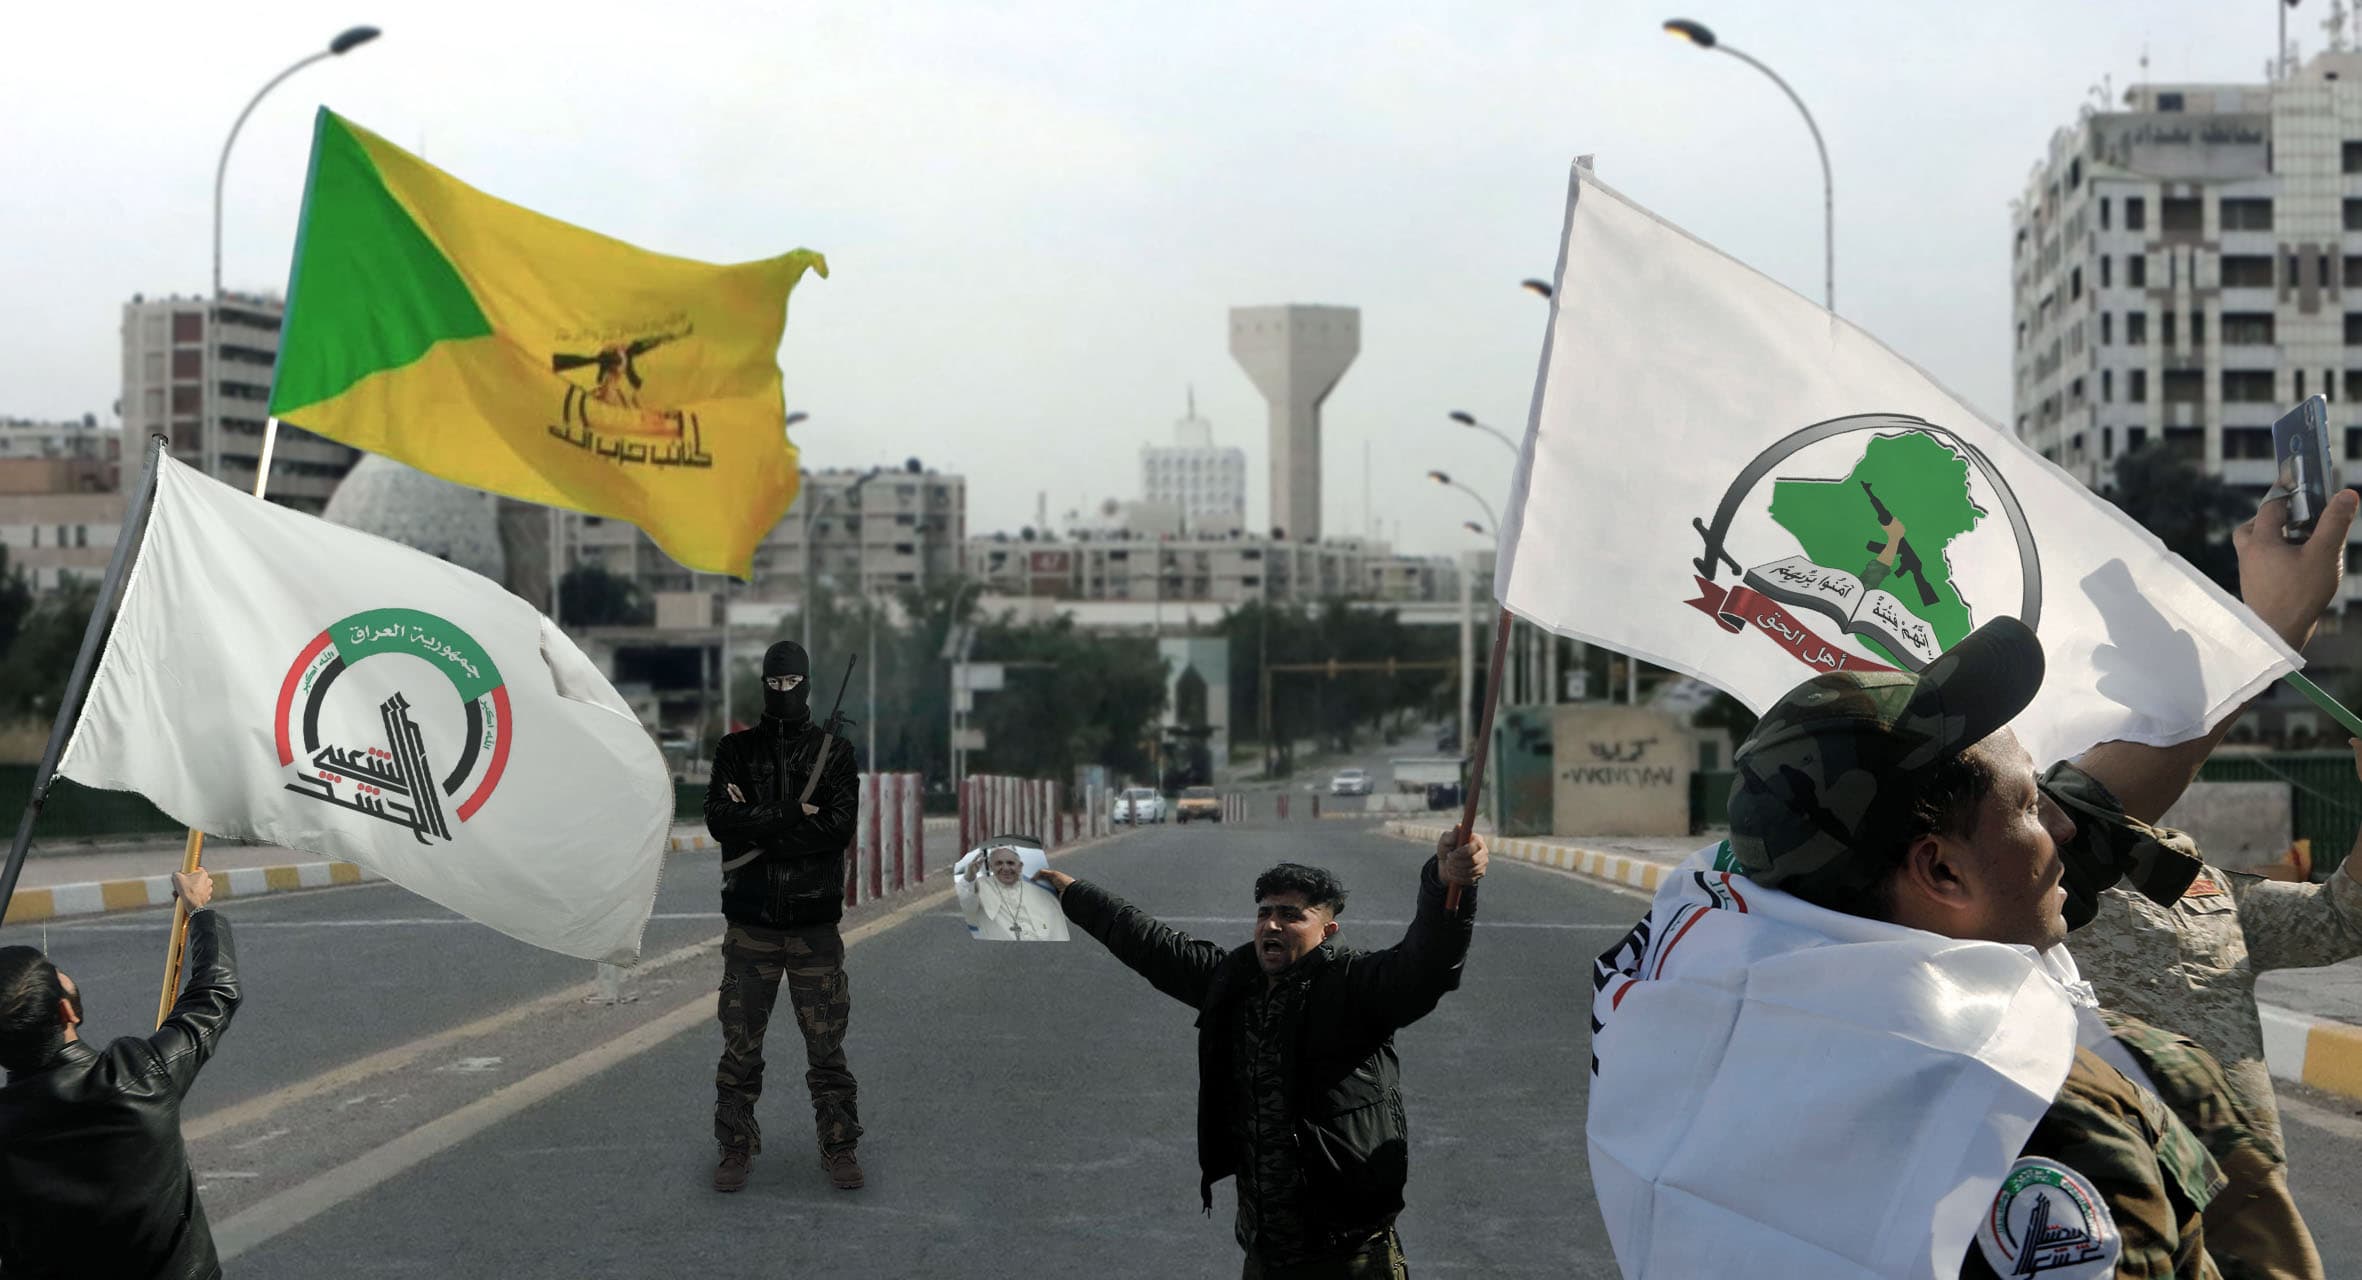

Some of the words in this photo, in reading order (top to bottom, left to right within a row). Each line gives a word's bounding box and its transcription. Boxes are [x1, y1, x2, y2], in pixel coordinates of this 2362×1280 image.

[349, 623, 405, 645] العراق
[1756, 612, 1807, 645] الحق
[409, 625, 481, 679] جمهورية
